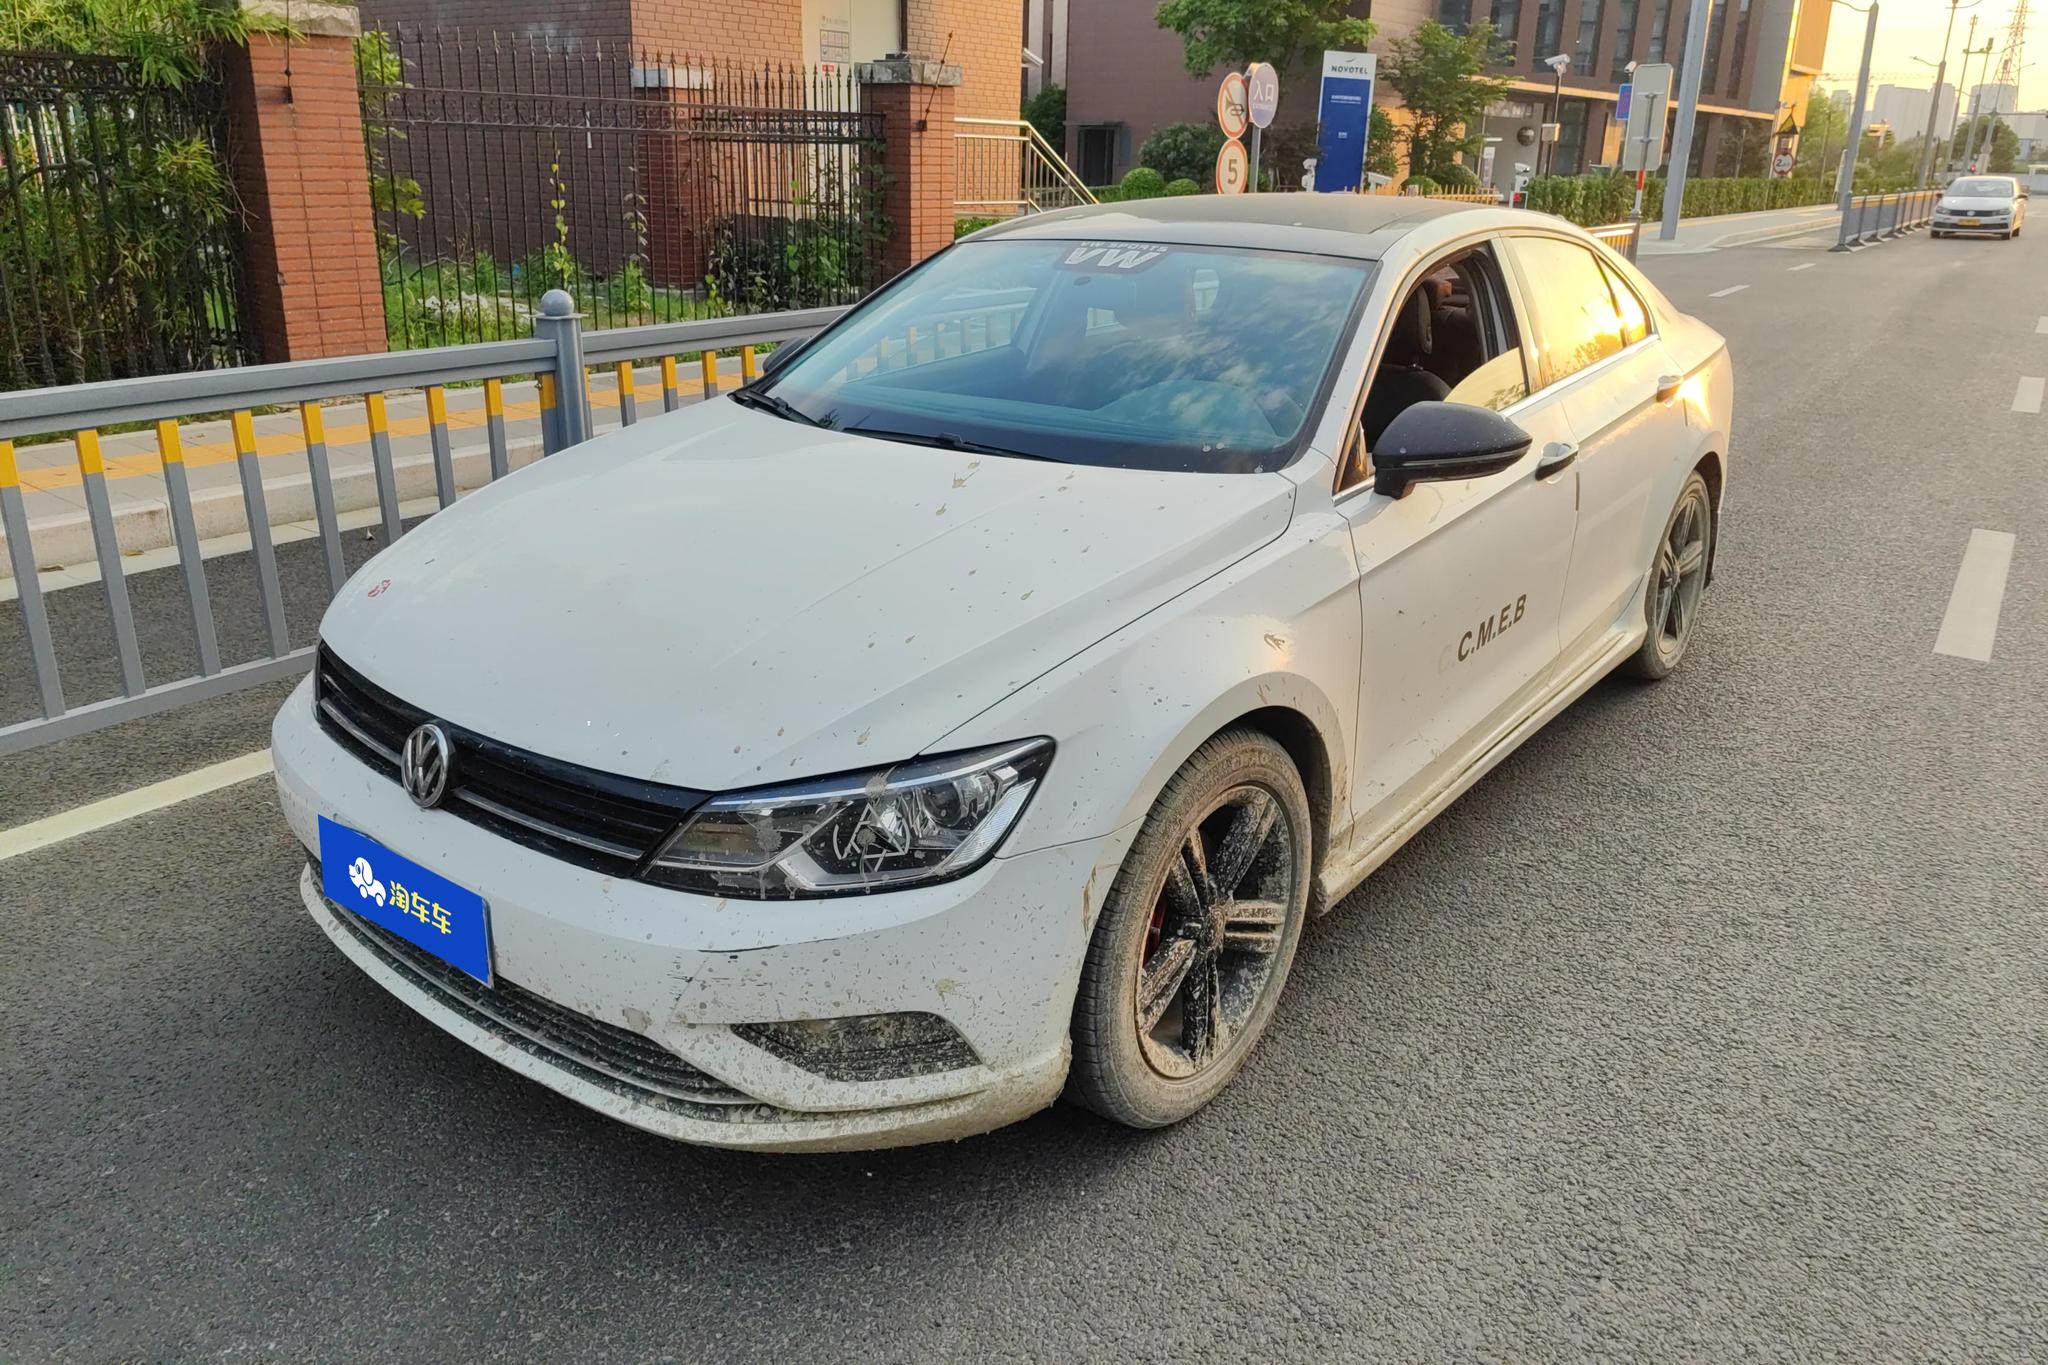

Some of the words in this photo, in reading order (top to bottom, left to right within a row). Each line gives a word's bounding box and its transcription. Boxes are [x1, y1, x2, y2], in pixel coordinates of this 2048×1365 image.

[1331, 65, 1368, 74] NOVOTEL
[1253, 80, 1273, 101] 入口
[1228, 158, 1237, 184] 5
[1064, 247, 1161, 268] VW
[1458, 594, 1527, 662] C.M.E.B
